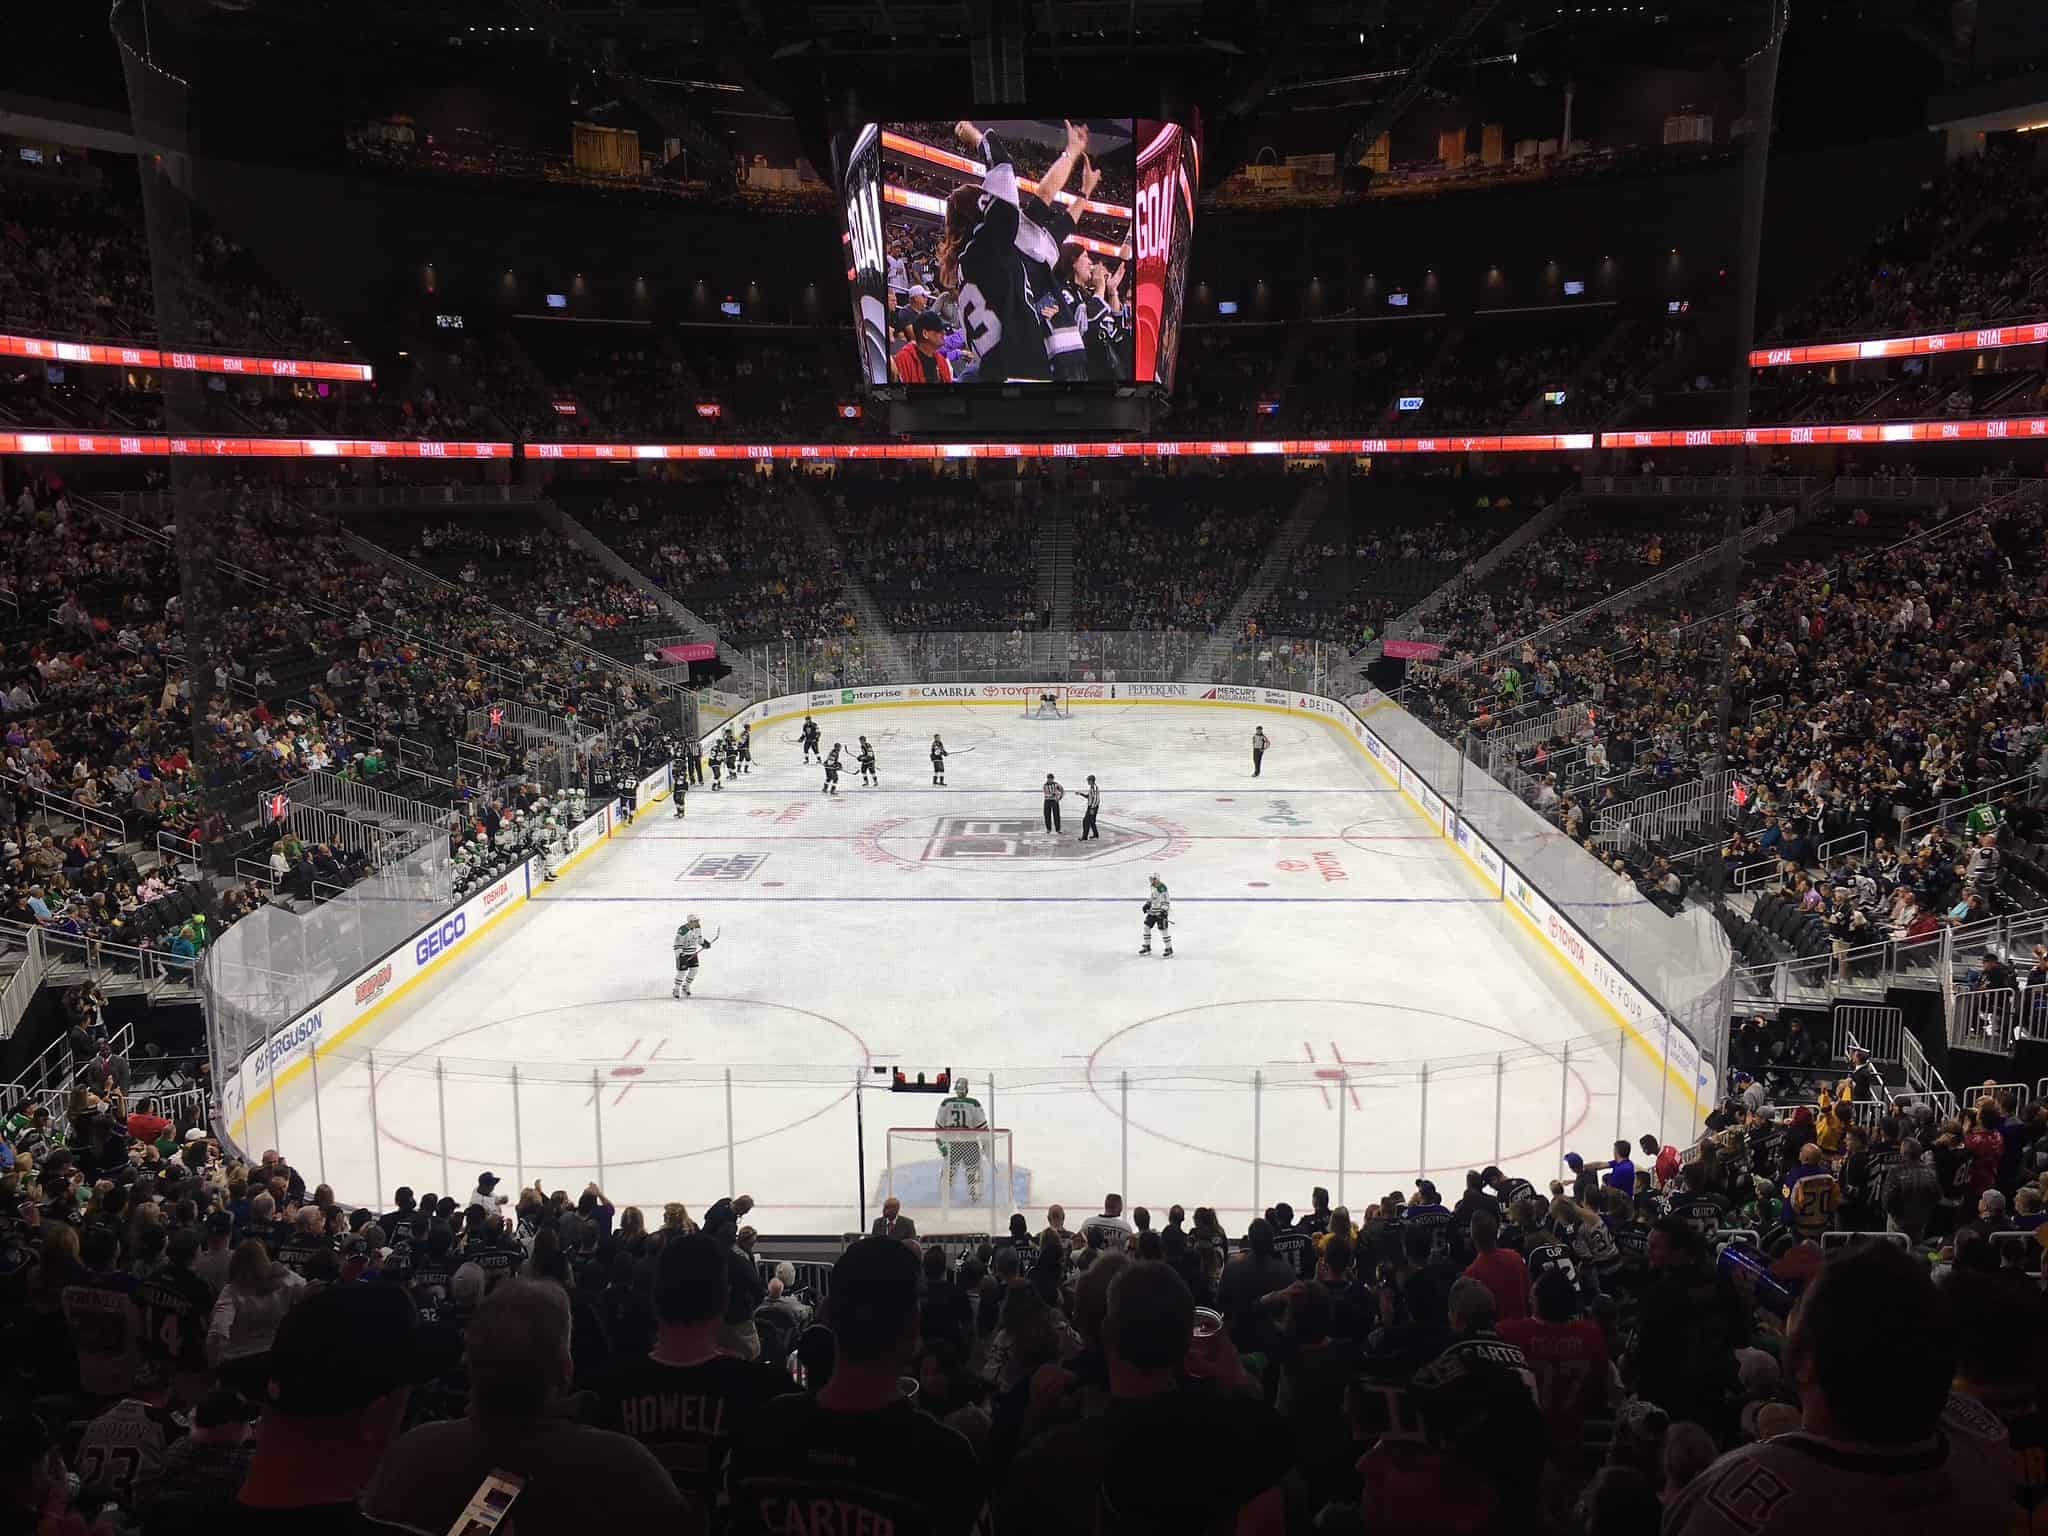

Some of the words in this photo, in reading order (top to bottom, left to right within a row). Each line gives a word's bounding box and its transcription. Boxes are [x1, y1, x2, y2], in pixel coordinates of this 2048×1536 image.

[1977, 328, 2003, 345] GOAL
[1987, 422, 2008, 438] GOAL
[1686, 431, 1712, 445] GOAL
[419, 443, 447, 457] GOAL
[540, 445, 562, 457] GOAL
[1053, 444, 1079, 456] GOAL
[1157, 442, 1180, 455] GOAL
[1362, 440, 1389, 453] GOAL
[922, 687, 976, 697] CAMBRIA
[1128, 684, 1188, 697] PEPPERDINE
[1217, 687, 1257, 696] MERCURY
[1217, 694, 1257, 703] INSURANCE
[1308, 698, 1335, 712] DELTA
[483, 882, 508, 907] TOSHIBA
[416, 912, 466, 966] GEICO
[1558, 922, 1585, 964] TOYOTA
[264, 1011, 323, 1066] FERGUSON
[951, 1110, 967, 1128] 31
